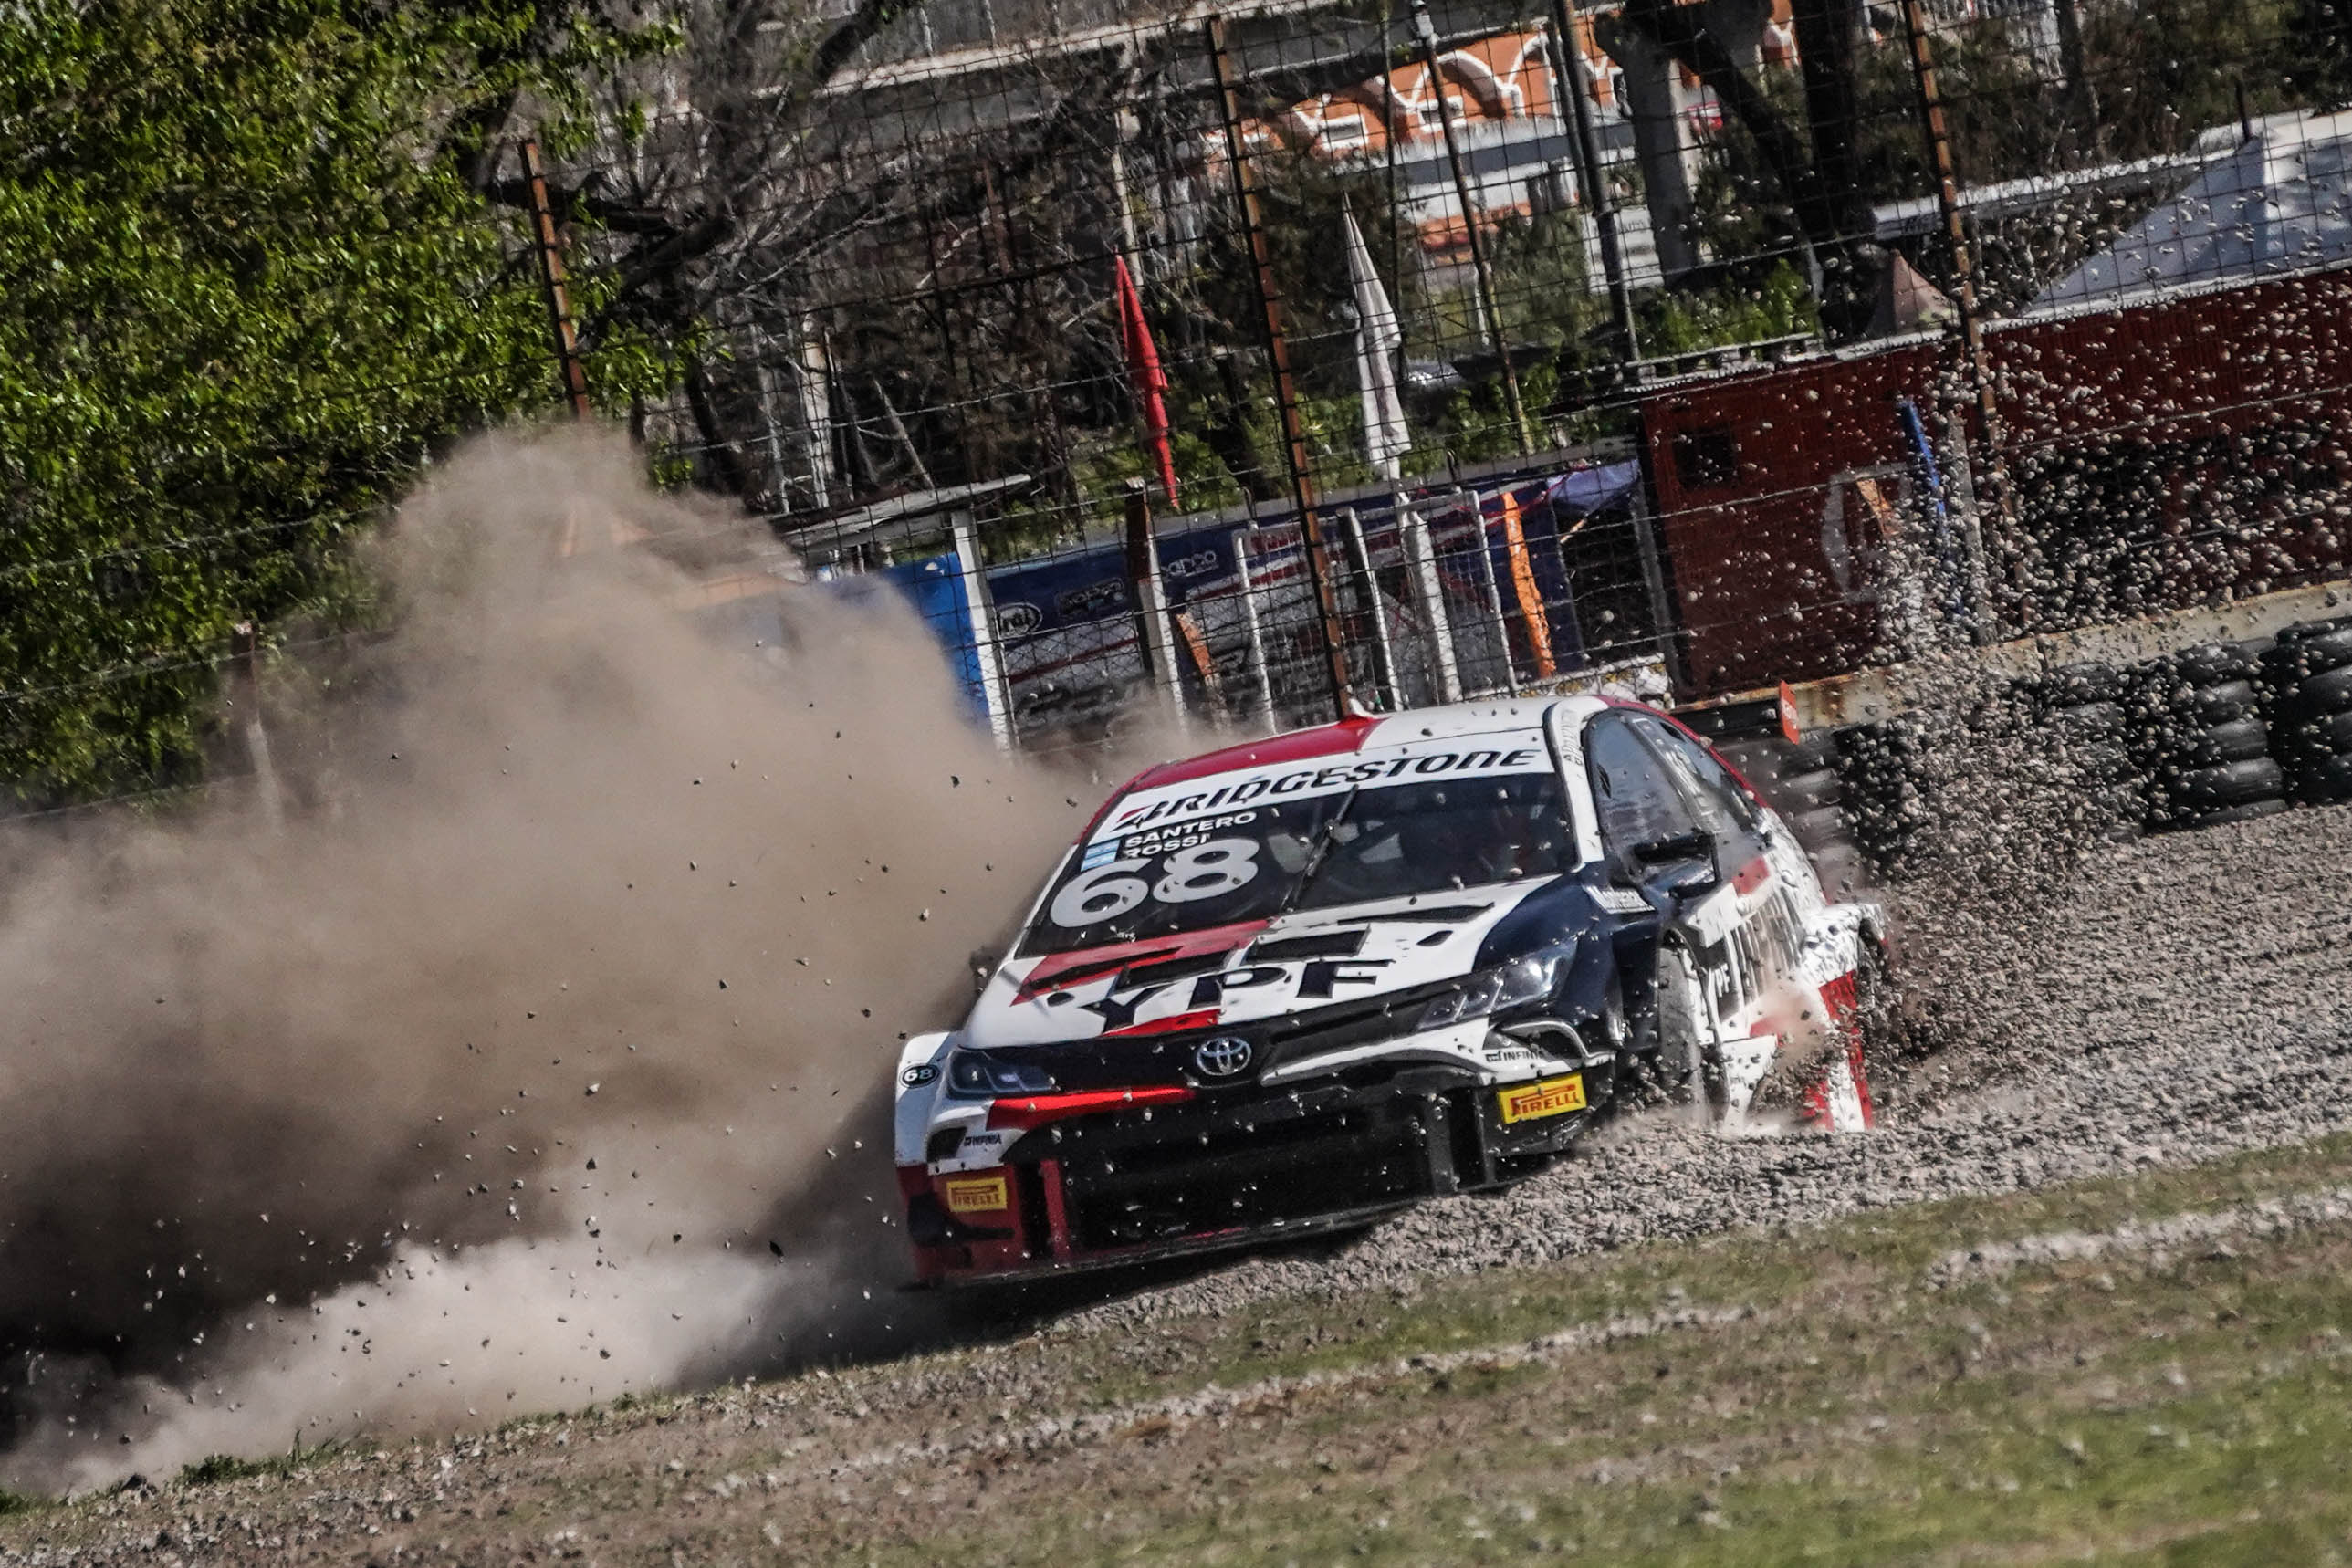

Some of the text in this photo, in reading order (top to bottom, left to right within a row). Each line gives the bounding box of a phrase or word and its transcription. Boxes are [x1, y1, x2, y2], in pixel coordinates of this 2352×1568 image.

[1111, 748, 1542, 832] BRIDGESTONE
[1124, 811, 1257, 848] SANTERO
[1124, 832, 1211, 859] ROSSI
[1051, 839, 1260, 928] 68
[1079, 958, 1396, 1033] YPF
[1503, 1051, 1543, 1061] INFINI
[904, 1068, 934, 1083] 68
[1510, 1083, 1580, 1117] PIRELLI
